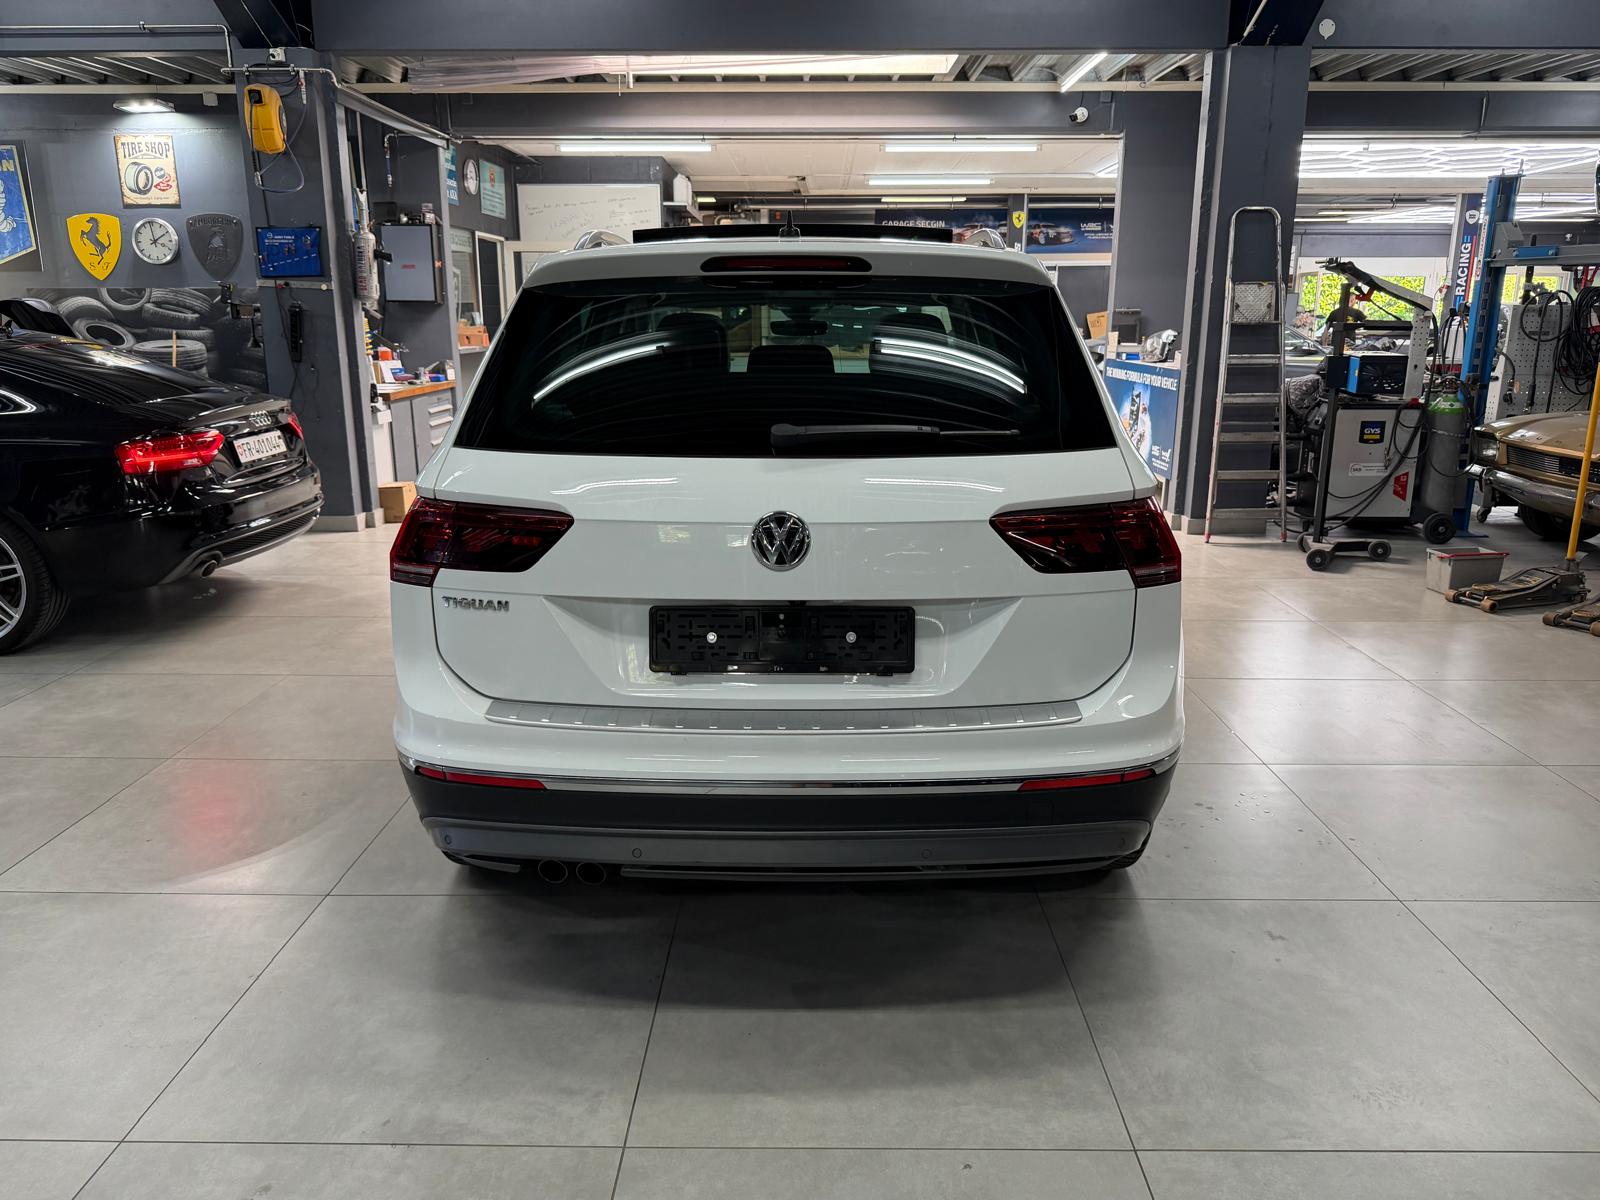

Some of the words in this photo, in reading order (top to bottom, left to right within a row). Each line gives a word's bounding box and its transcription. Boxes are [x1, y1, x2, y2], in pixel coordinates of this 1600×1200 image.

[121, 142, 143, 159] TIRE
[145, 142, 170, 158] SHOP
[0, 159, 15, 172] N
[1455, 243, 1472, 296] RACING
[441, 596, 510, 612] TIGUAN
